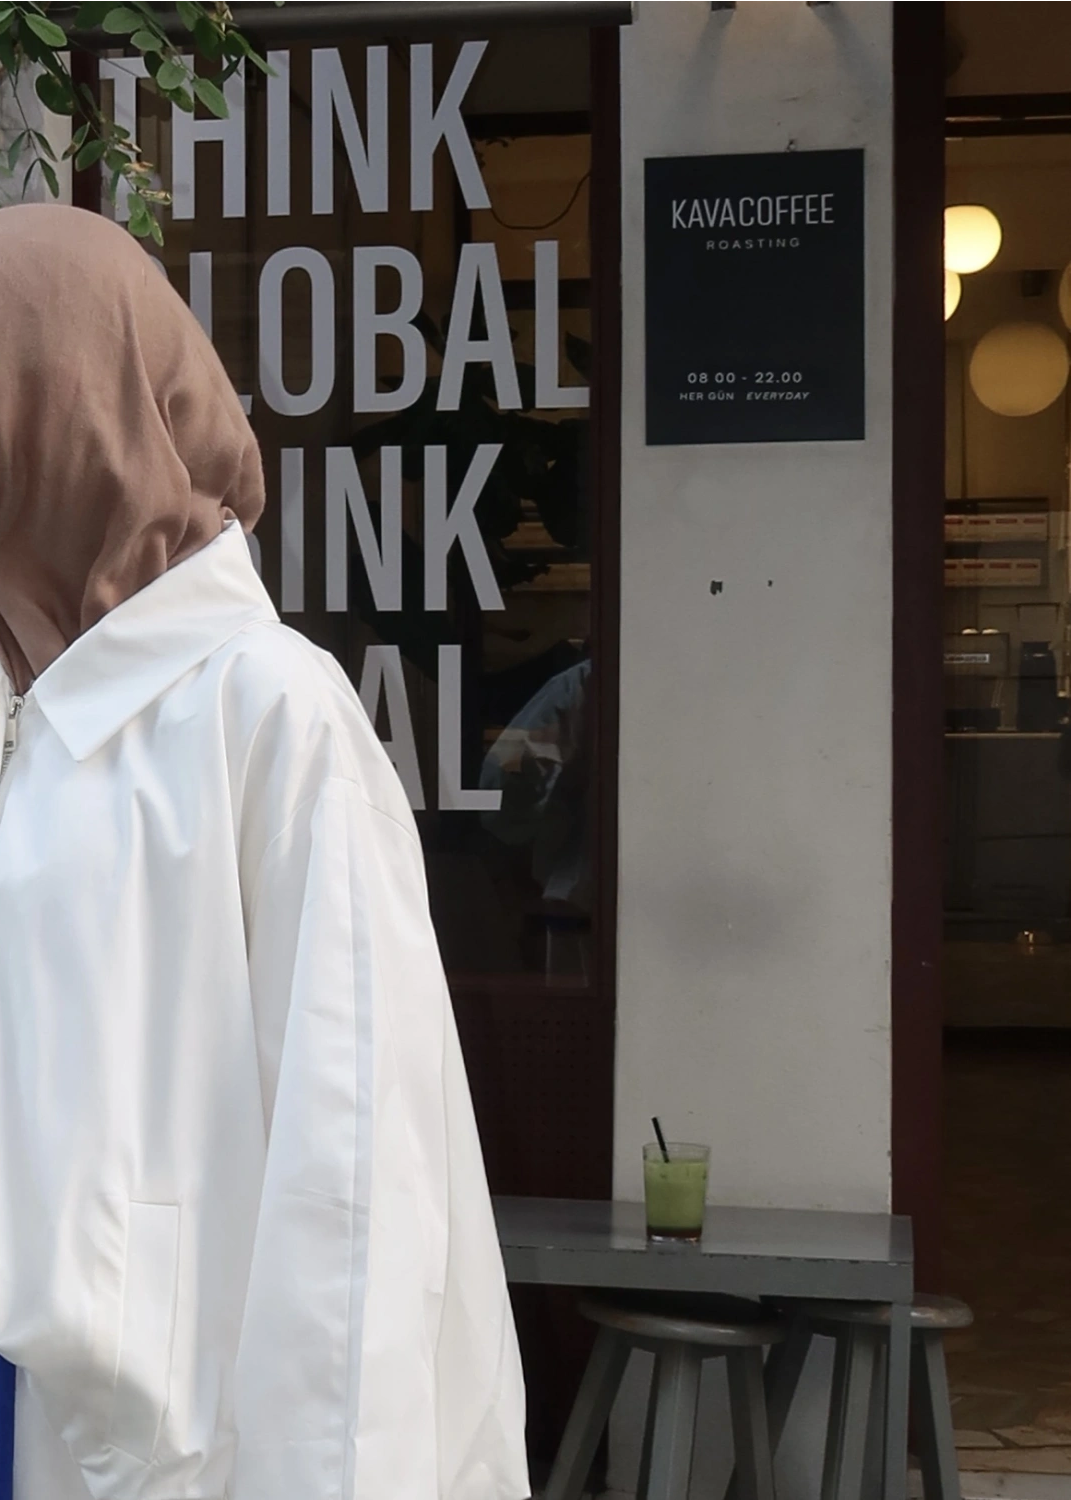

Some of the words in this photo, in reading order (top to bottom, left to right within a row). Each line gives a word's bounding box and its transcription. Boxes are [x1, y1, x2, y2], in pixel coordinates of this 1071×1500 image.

[99, 40, 492, 222] THINK
[672, 193, 835, 229] KAVACOFFEE
[706, 237, 800, 250] ROASTING
[151, 240, 591, 417] OBAL
[679, 392, 704, 401] HER
[707, 390, 734, 401] GÜN
[746, 391, 810, 401] EVERYDAY
[754, 371, 803, 384] 22.00
[247, 443, 506, 613] INK
